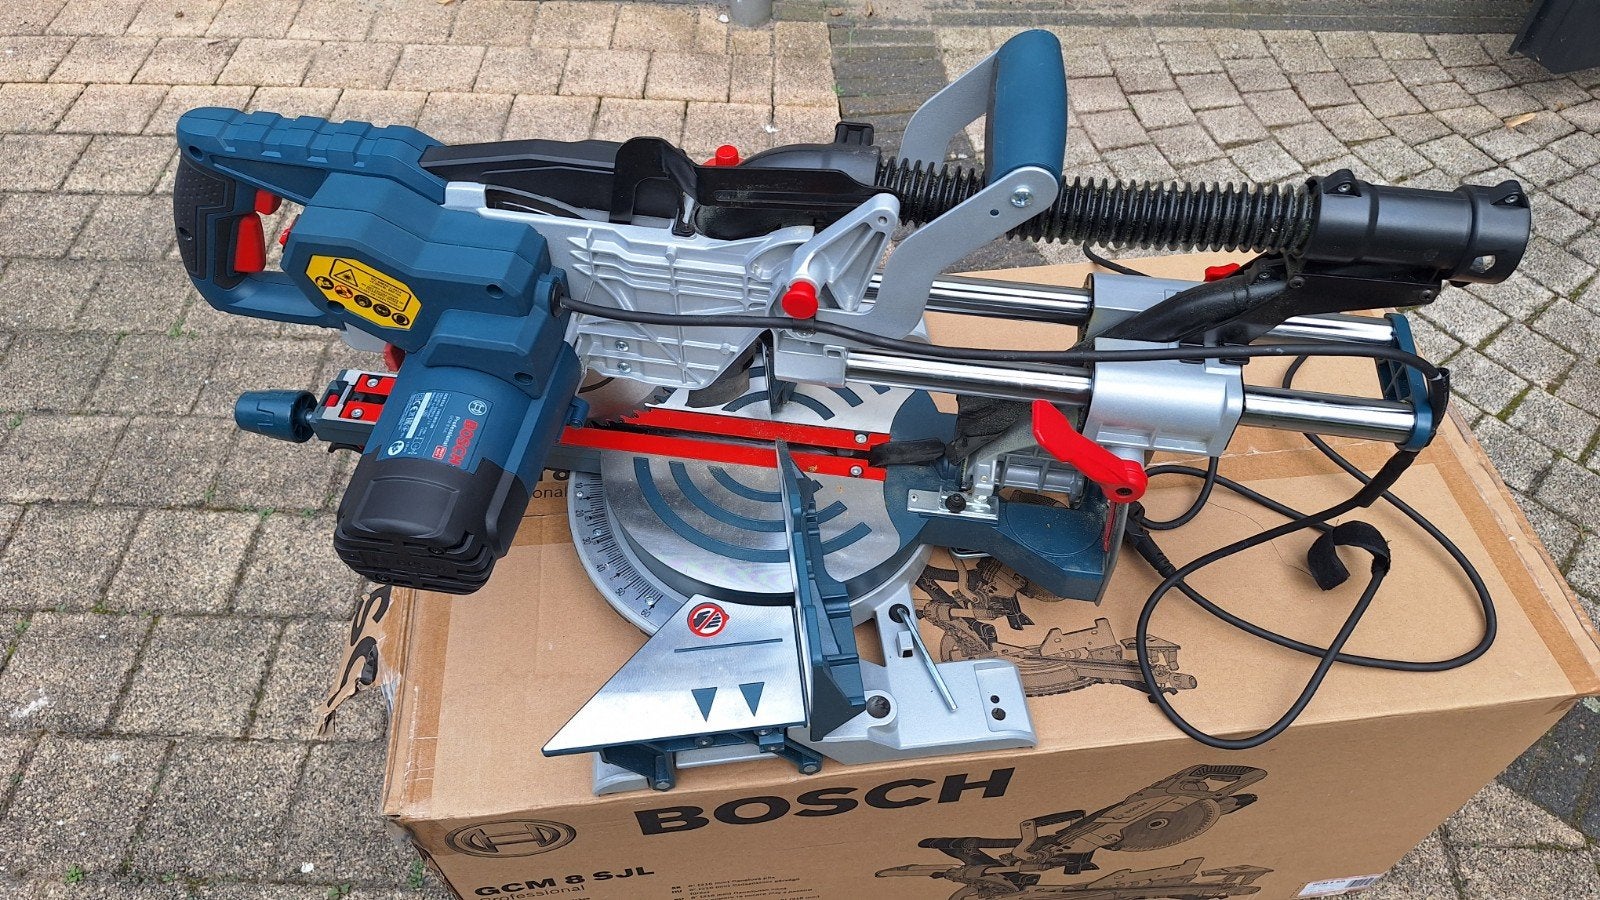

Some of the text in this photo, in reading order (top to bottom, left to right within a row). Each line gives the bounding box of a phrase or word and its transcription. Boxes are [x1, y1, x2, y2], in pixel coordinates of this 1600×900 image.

[442, 415, 461, 447] Professional
[448, 418, 479, 466] BOSCH
[596, 563, 606, 573] 40
[614, 586, 625, 597] 50
[640, 608, 651, 618] 60
[634, 767, 1016, 836] BOSCH
[474, 866, 655, 896] GCM 8 SJL
